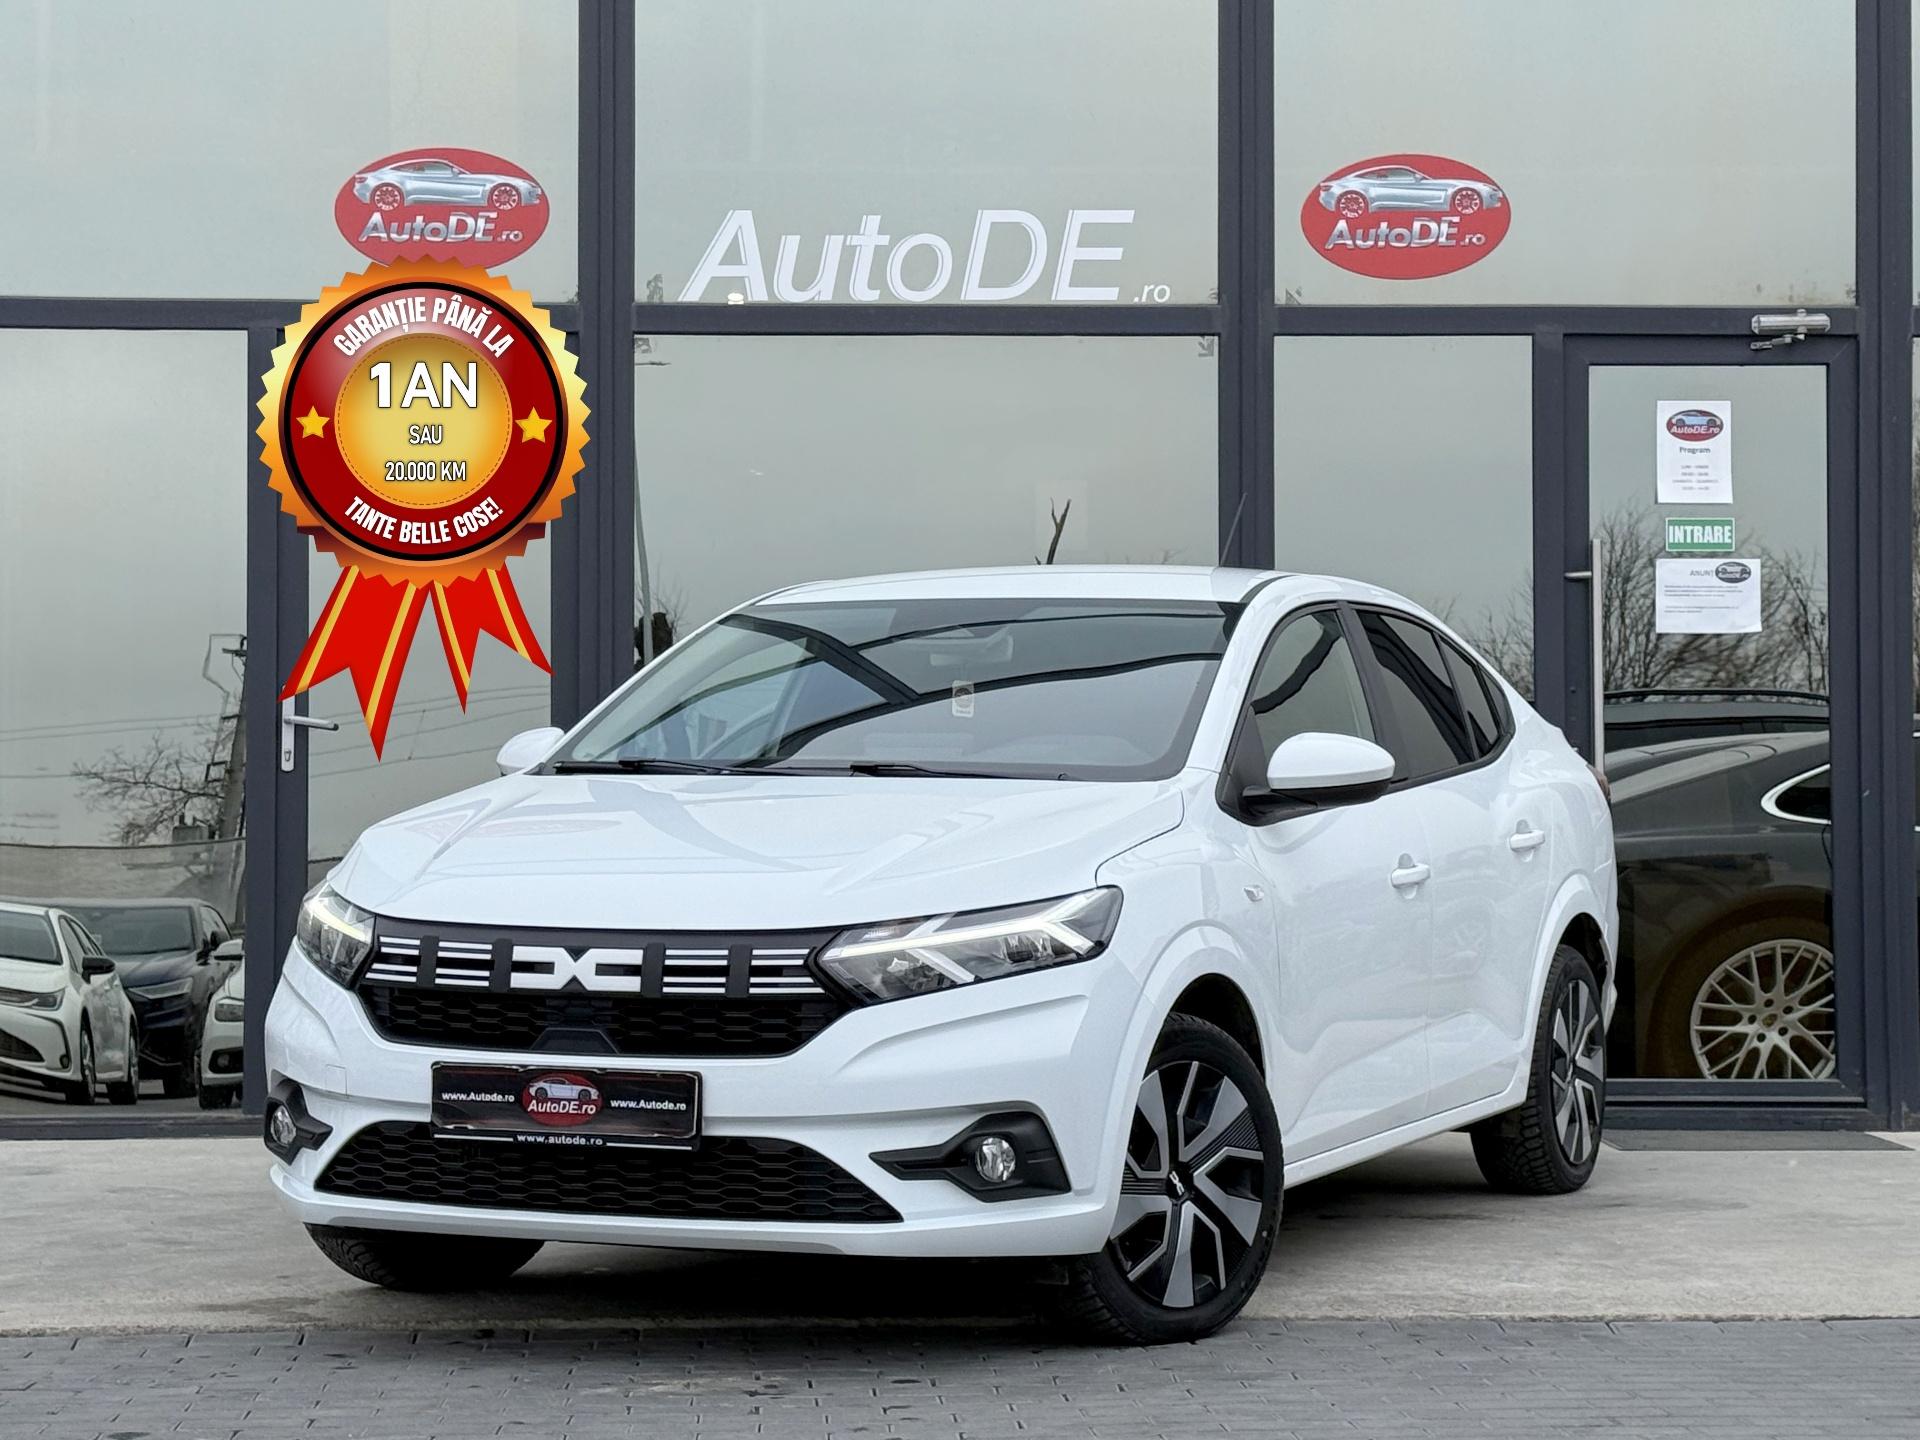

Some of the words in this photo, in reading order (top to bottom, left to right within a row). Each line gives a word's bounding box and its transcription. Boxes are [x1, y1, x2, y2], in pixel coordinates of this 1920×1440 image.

[1668, 525, 1732, 544] INTRARE
[441, 1091, 515, 1103] www.Autode.ro
[527, 1099, 597, 1116] AutoDE.ro
[610, 1098, 687, 1112] www.Autode.ro
[516, 1133, 604, 1147] www.autode.ro
